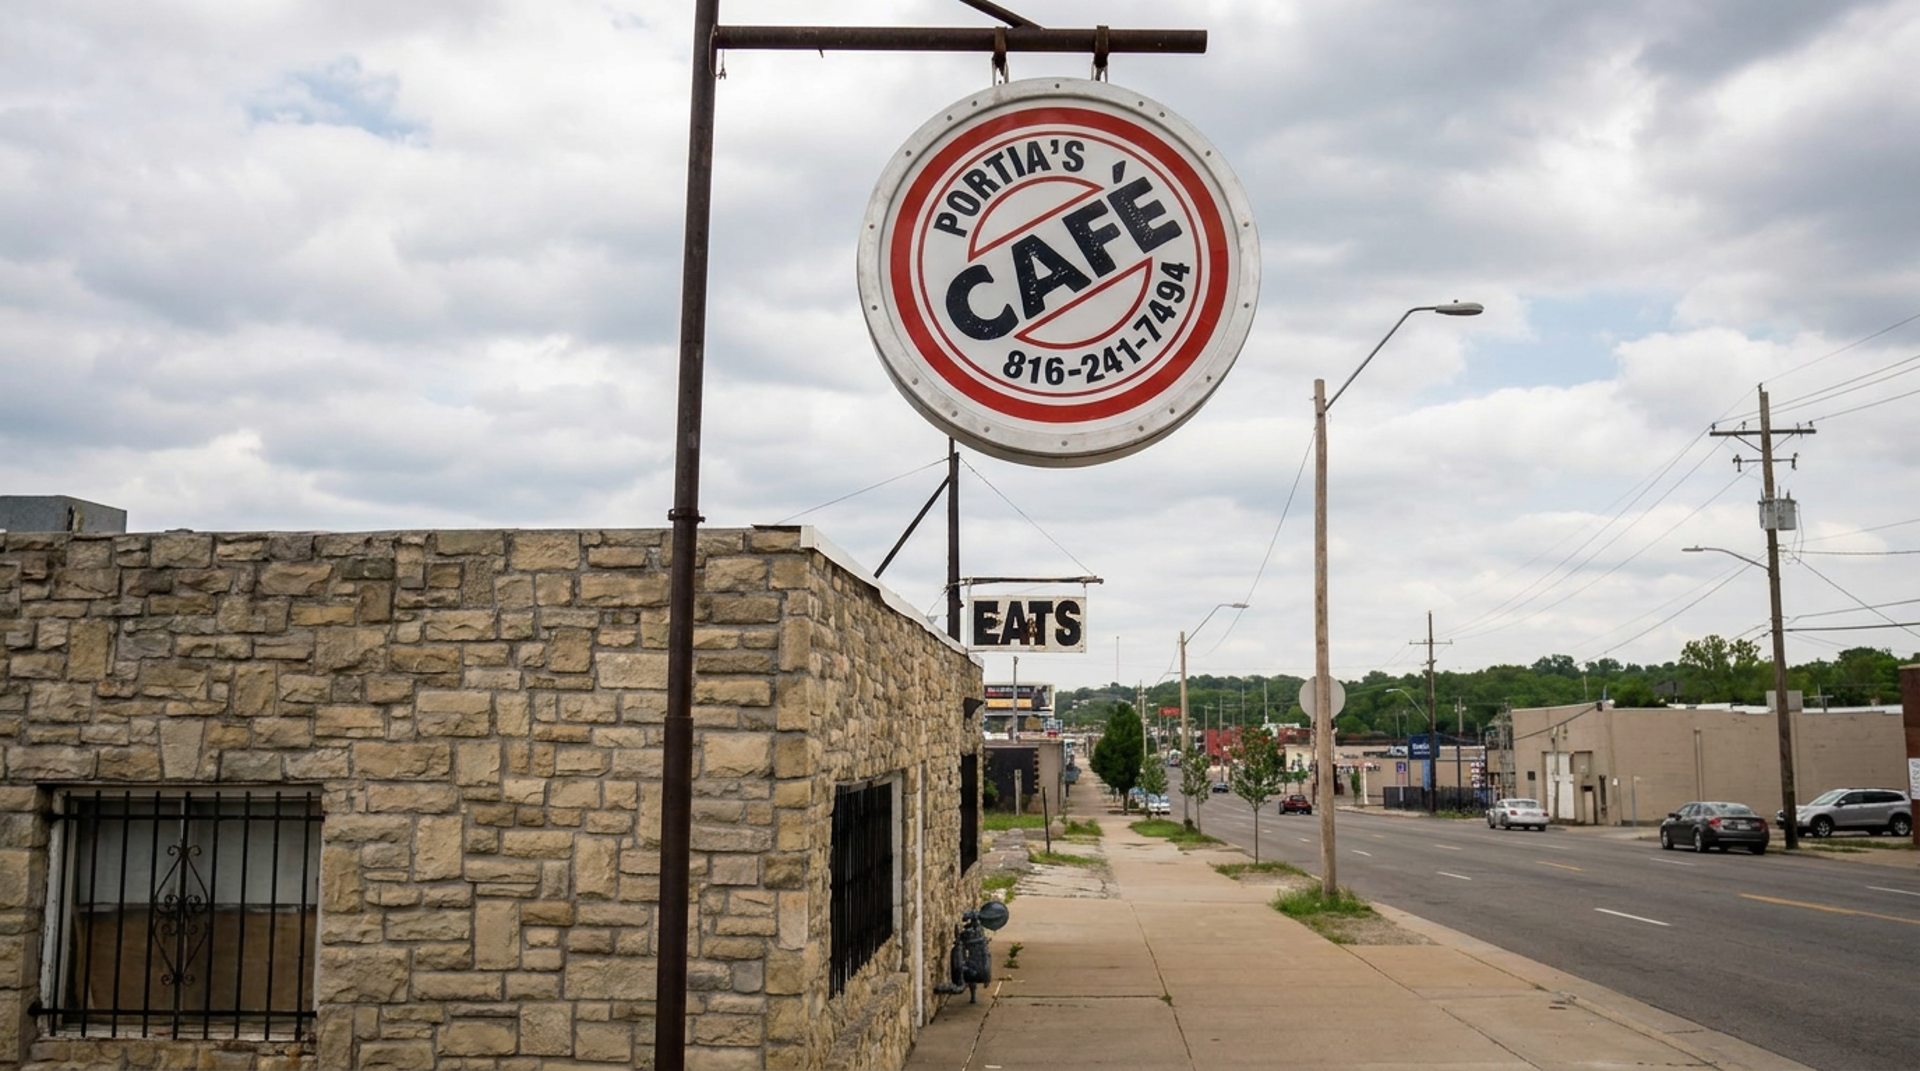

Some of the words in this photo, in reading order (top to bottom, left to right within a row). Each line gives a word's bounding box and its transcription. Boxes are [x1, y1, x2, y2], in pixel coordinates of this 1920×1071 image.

[934, 139, 1085, 238] PORTIA'S
[946, 161, 1183, 341] CAFÉ
[1003, 262, 1190, 385] 816-241-7494
[974, 600, 1081, 646] EATS
